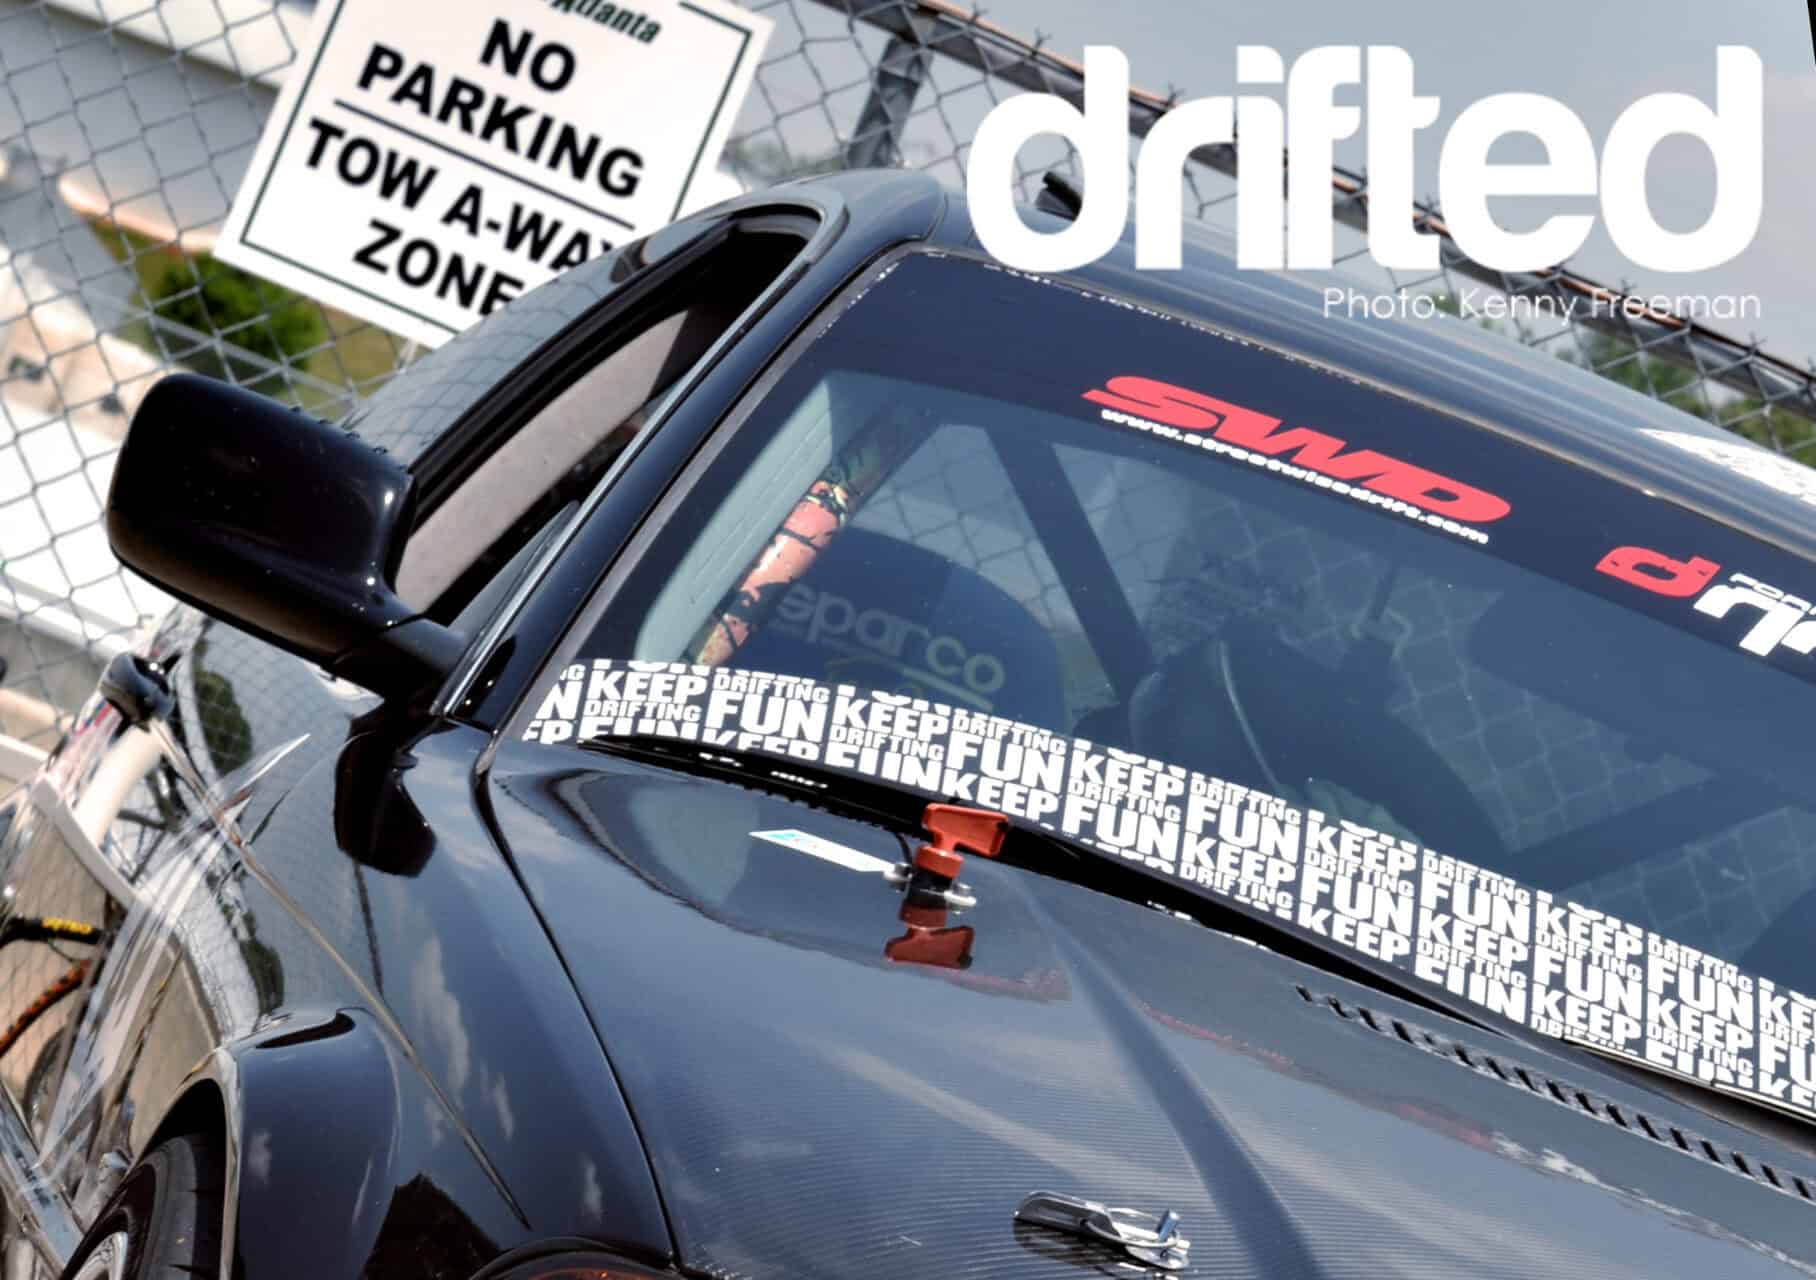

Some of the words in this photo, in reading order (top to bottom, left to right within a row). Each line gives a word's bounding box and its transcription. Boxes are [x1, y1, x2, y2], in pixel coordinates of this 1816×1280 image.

[480, 19, 577, 93] NO
[356, 43, 645, 199] PARKING
[304, 117, 439, 210] TOW
[441, 185, 613, 272] A-WA
[1081, 375, 1511, 523] SWD
[777, 583, 1007, 693] sparco
[583, 699, 702, 723] DRIFTING
[587, 670, 707, 704] KEEP
[705, 689, 829, 742] FUN
[714, 673, 830, 703] DRIFTING
[830, 723, 945, 761] DRIFTING
[831, 695, 949, 742] KEEP
[951, 714, 1068, 755] DRIFTING
[946, 730, 1065, 795] FUN
[1070, 749, 1186, 798] KEEP
[942, 768, 1060, 821] KEEP
[1067, 776, 1182, 823] DRIFTING
[1191, 777, 1302, 826] DRIFTING
[1062, 792, 1180, 862] FUN
[1185, 792, 1301, 863] FUN
[1305, 820, 1417, 878] KEEP
[1179, 861, 1294, 909] DRIFTING
[1182, 831, 1297, 890] KEEP
[1304, 846, 1415, 897] DRIFTING
[1422, 854, 1531, 907] DRIFTING
[1301, 862, 1414, 938] FUN
[1420, 868, 1530, 944] FUN
[1297, 899, 1411, 963] KEEP
[1417, 907, 1529, 969] KEEP
[1535, 928, 1643, 982] DRIFTING
[1537, 902, 1644, 962] KEEP
[1416, 935, 1528, 989] DRIFTING
[1533, 943, 1643, 1022] FUN
[1647, 951, 1754, 1031] FUN
[1648, 938, 1754, 993] DRIFTING
[1532, 981, 1642, 1049] KEEP
[1647, 990, 1754, 1055] KEEP
[1759, 986, 1816, 1038] KE
[1646, 1017, 1754, 1077] DRIFTING
